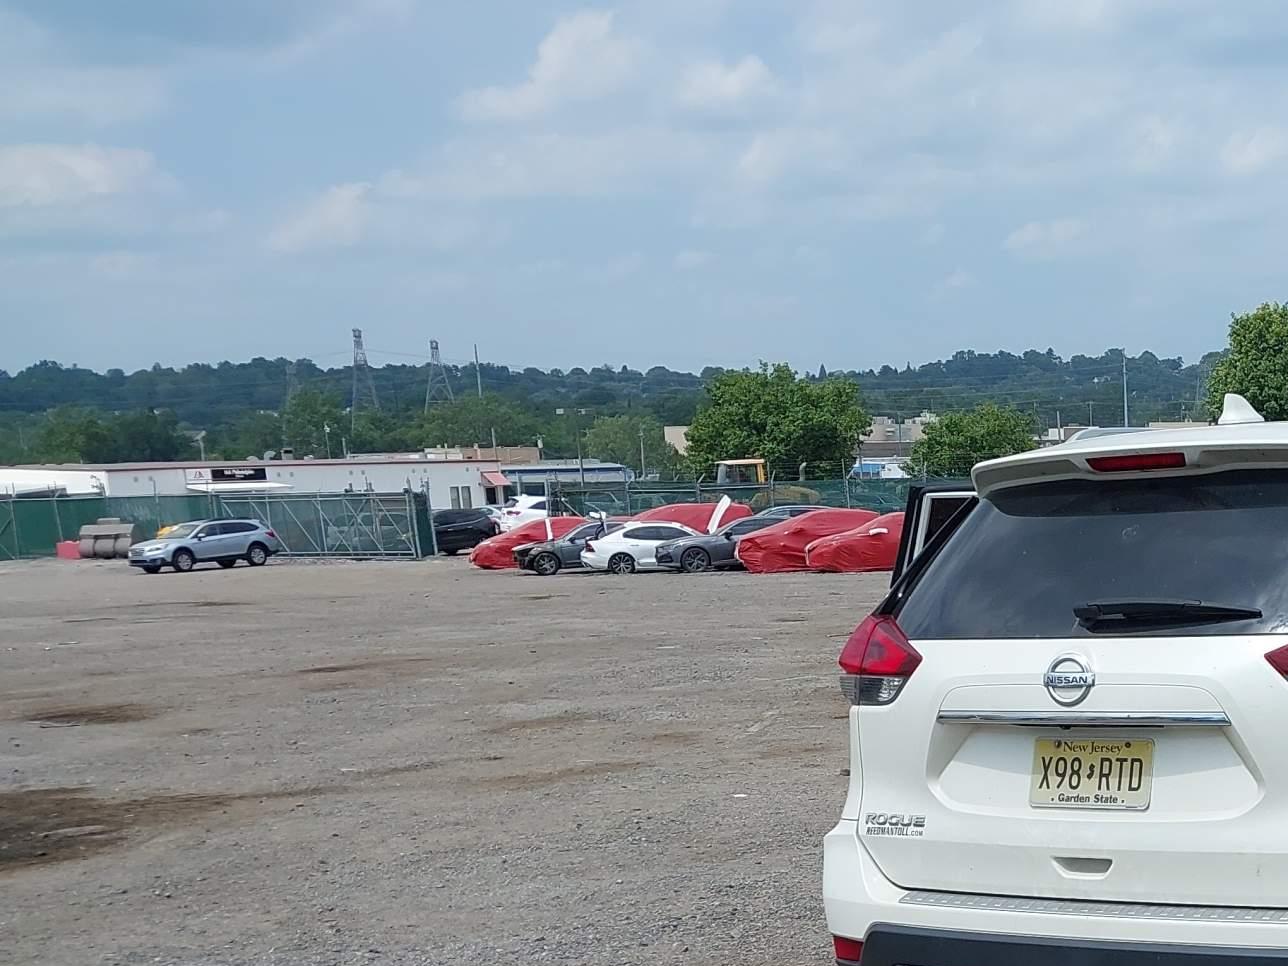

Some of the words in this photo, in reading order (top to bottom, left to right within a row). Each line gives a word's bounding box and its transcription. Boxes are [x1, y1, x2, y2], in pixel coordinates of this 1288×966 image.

[1047, 676, 1088, 684] NISSAN
[1063, 741, 1088, 753] New
[1089, 741, 1123, 755] Jersey
[1038, 756, 1083, 790] X98
[1097, 757, 1144, 792] RTD
[1058, 793, 1090, 803] Garden
[1093, 794, 1118, 804] State
[864, 813, 926, 828] ROGUE
